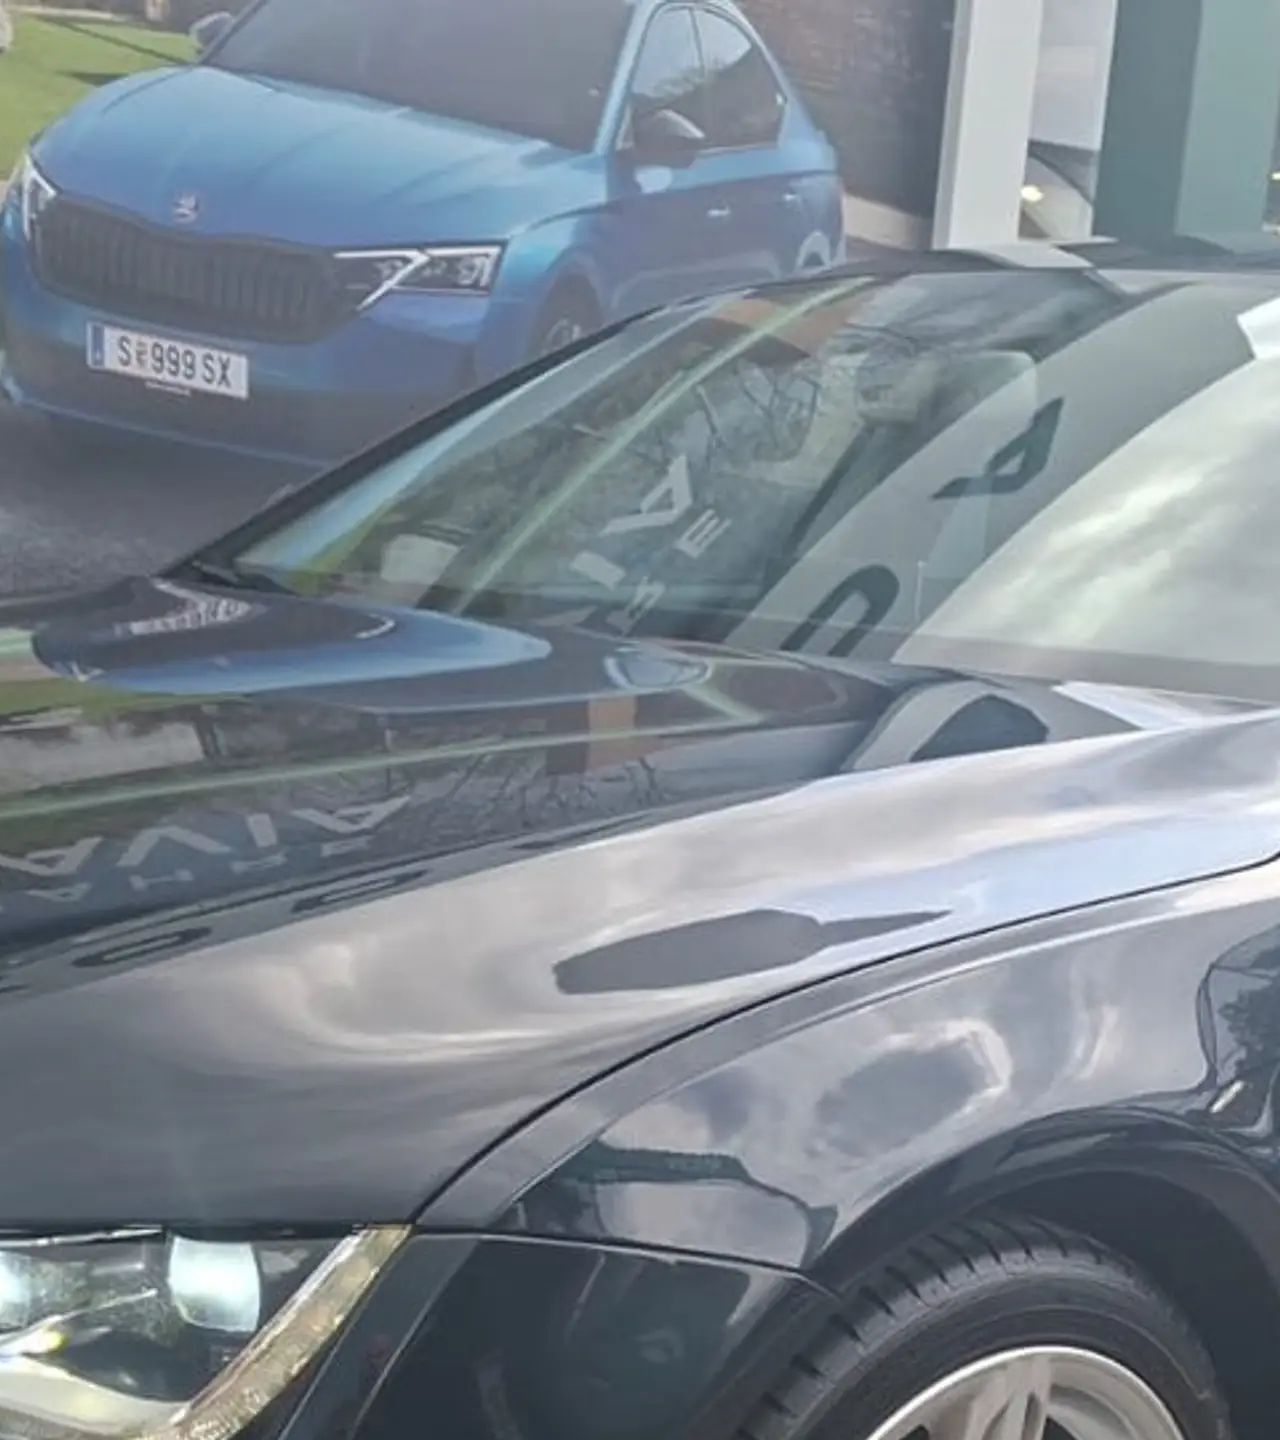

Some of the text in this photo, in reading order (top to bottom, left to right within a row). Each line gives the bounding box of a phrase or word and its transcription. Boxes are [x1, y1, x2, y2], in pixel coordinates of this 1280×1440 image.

[117, 335, 132, 367] S
[150, 341, 197, 381] 999
[201, 351, 233, 390] SX
